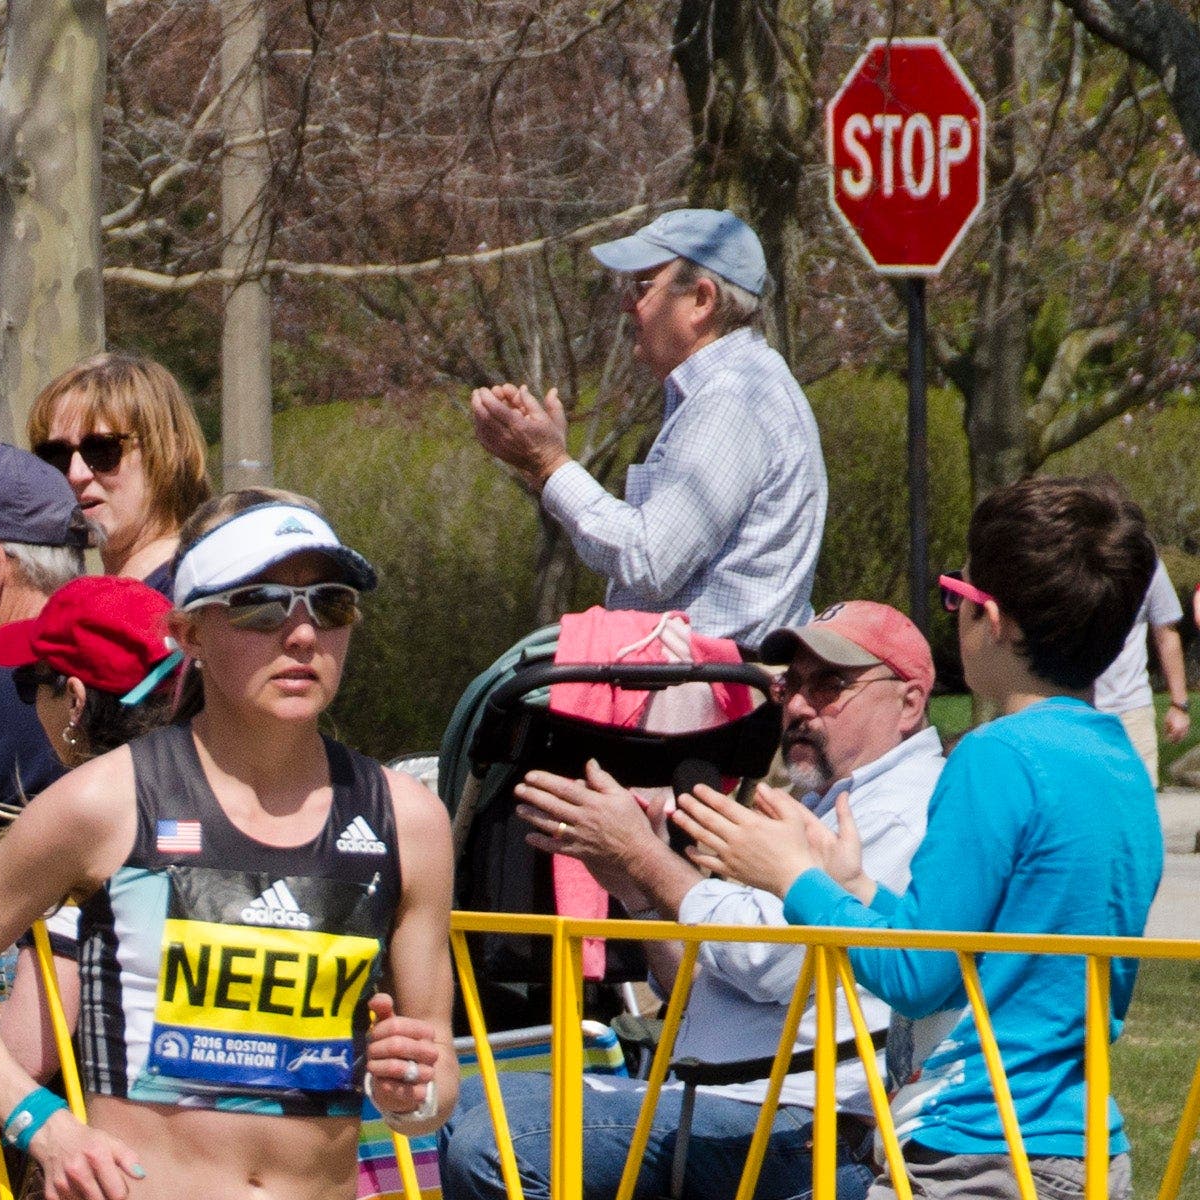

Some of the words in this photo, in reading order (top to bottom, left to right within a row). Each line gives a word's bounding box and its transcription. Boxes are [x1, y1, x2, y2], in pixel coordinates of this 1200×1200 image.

[841, 113, 972, 199] STOP
[336, 838, 387, 854] adidas
[241, 904, 311, 929] adidas
[162, 942, 369, 1019] NEELY
[193, 1034, 223, 1050] 2016
[225, 1038, 277, 1055] BOSTON
[190, 1048, 277, 1069] MARATHON
